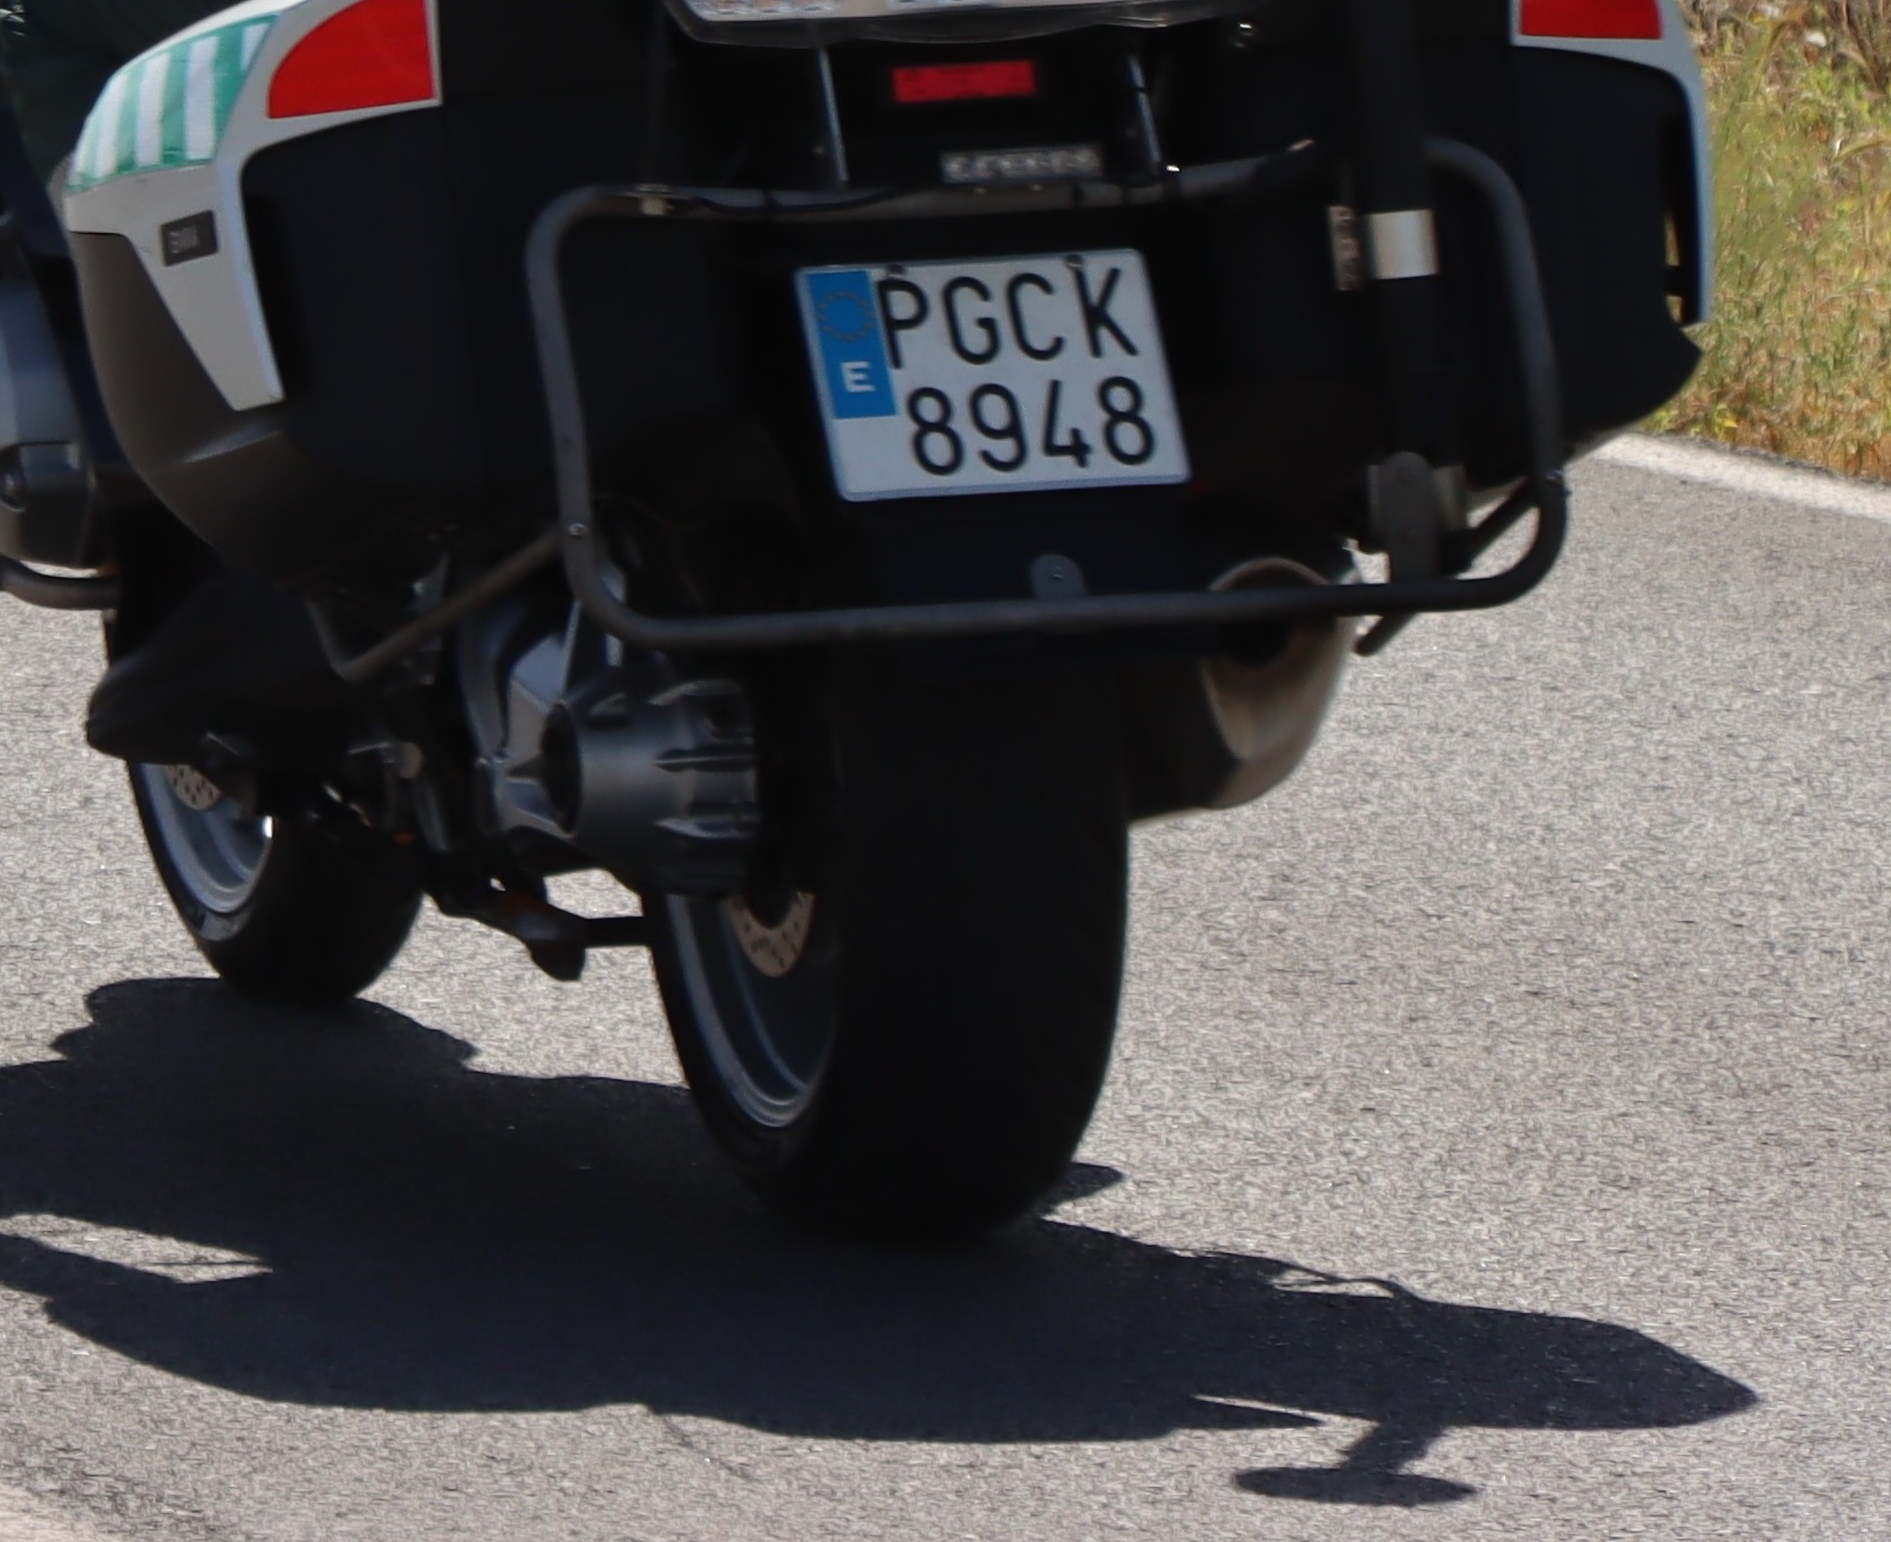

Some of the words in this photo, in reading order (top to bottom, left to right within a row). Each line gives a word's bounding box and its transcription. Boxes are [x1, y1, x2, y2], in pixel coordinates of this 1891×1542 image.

[877, 267, 1140, 370] PGCK
[840, 361, 876, 393] E
[907, 376, 1155, 476] 8948
